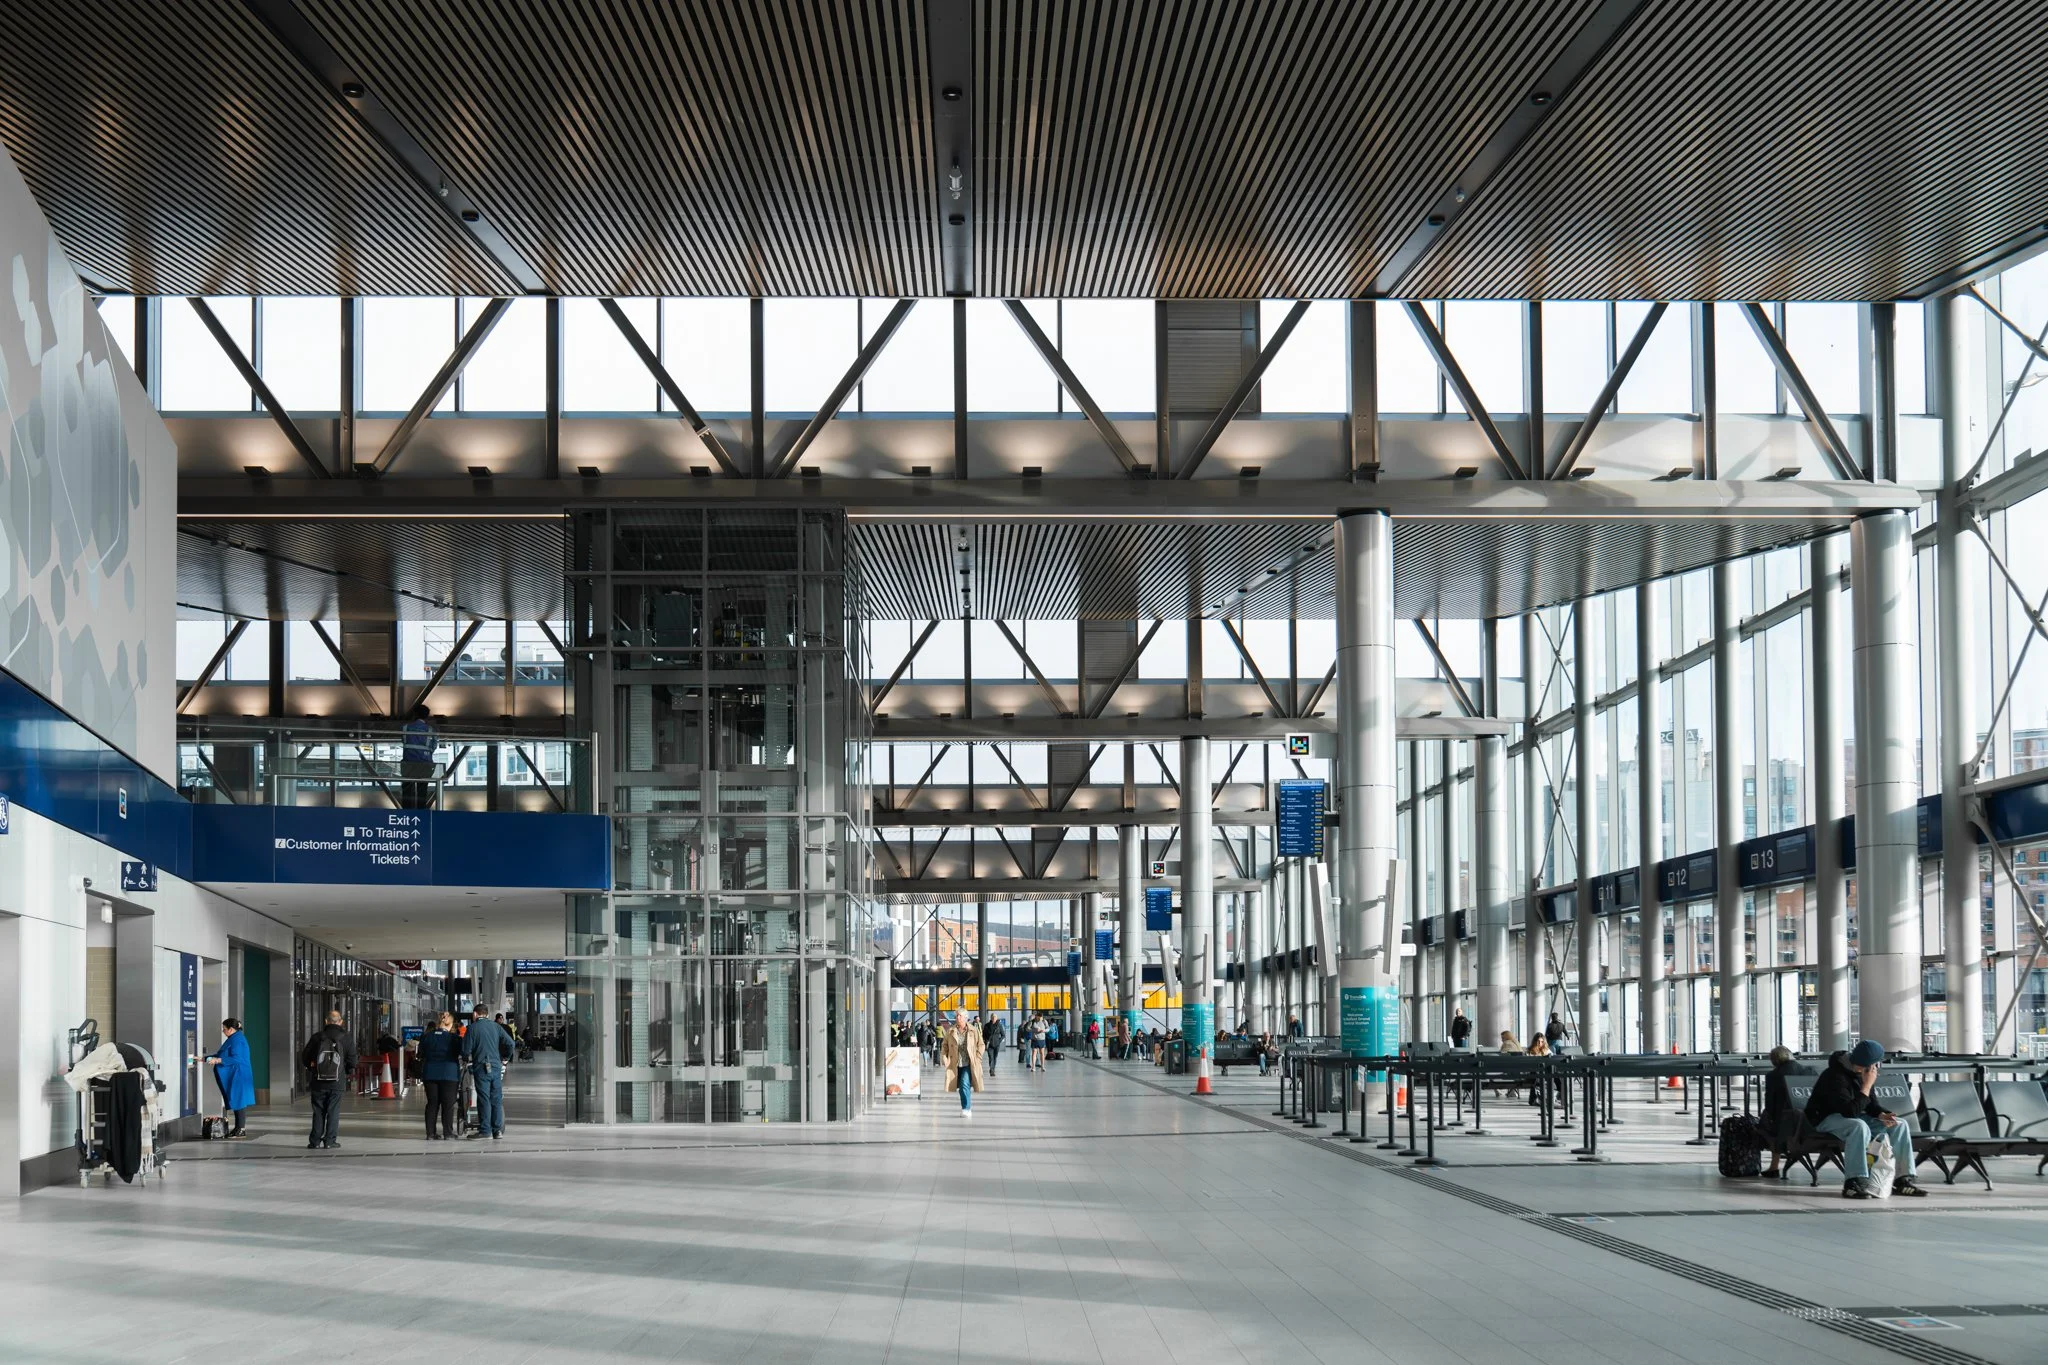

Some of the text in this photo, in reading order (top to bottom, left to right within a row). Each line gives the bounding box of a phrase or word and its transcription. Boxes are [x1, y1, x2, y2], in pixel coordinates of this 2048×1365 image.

[388, 815, 410, 825] Exit
[359, 827, 410, 838] To Trains
[286, 838, 410, 851] Customer Information
[370, 854, 410, 864] Tickets
[1761, 849, 1774, 868] 13
[1676, 868, 1686, 886] 12
[1606, 886, 1614, 895] 11
